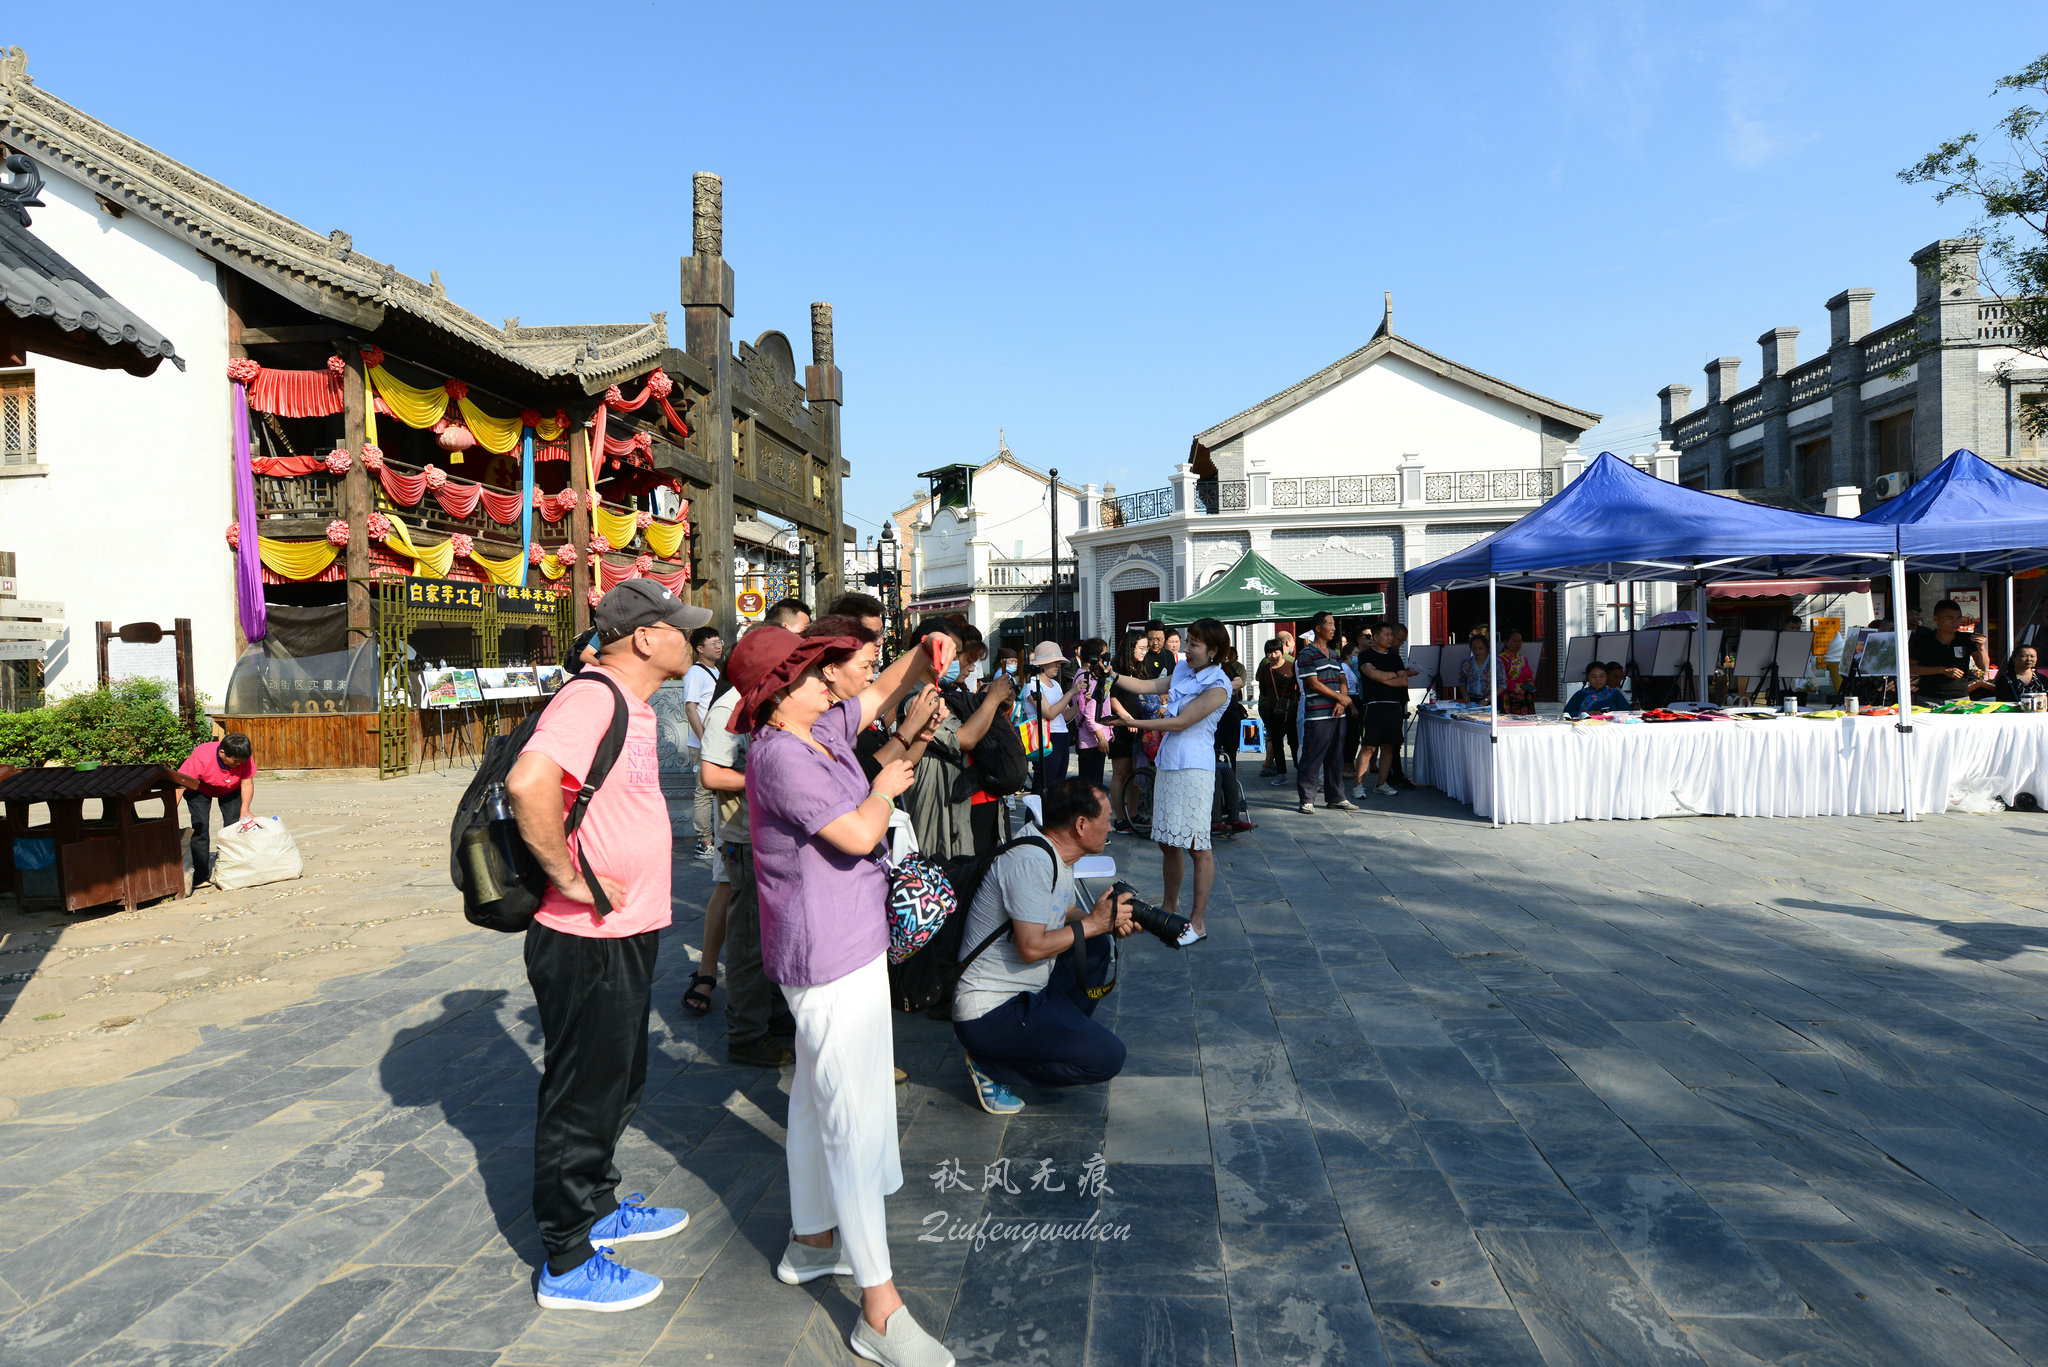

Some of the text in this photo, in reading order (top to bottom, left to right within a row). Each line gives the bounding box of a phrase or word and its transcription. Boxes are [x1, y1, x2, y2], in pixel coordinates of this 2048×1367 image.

[410, 583, 483, 608] 白家手工包
[506, 586, 556, 603] 桂林米粉
